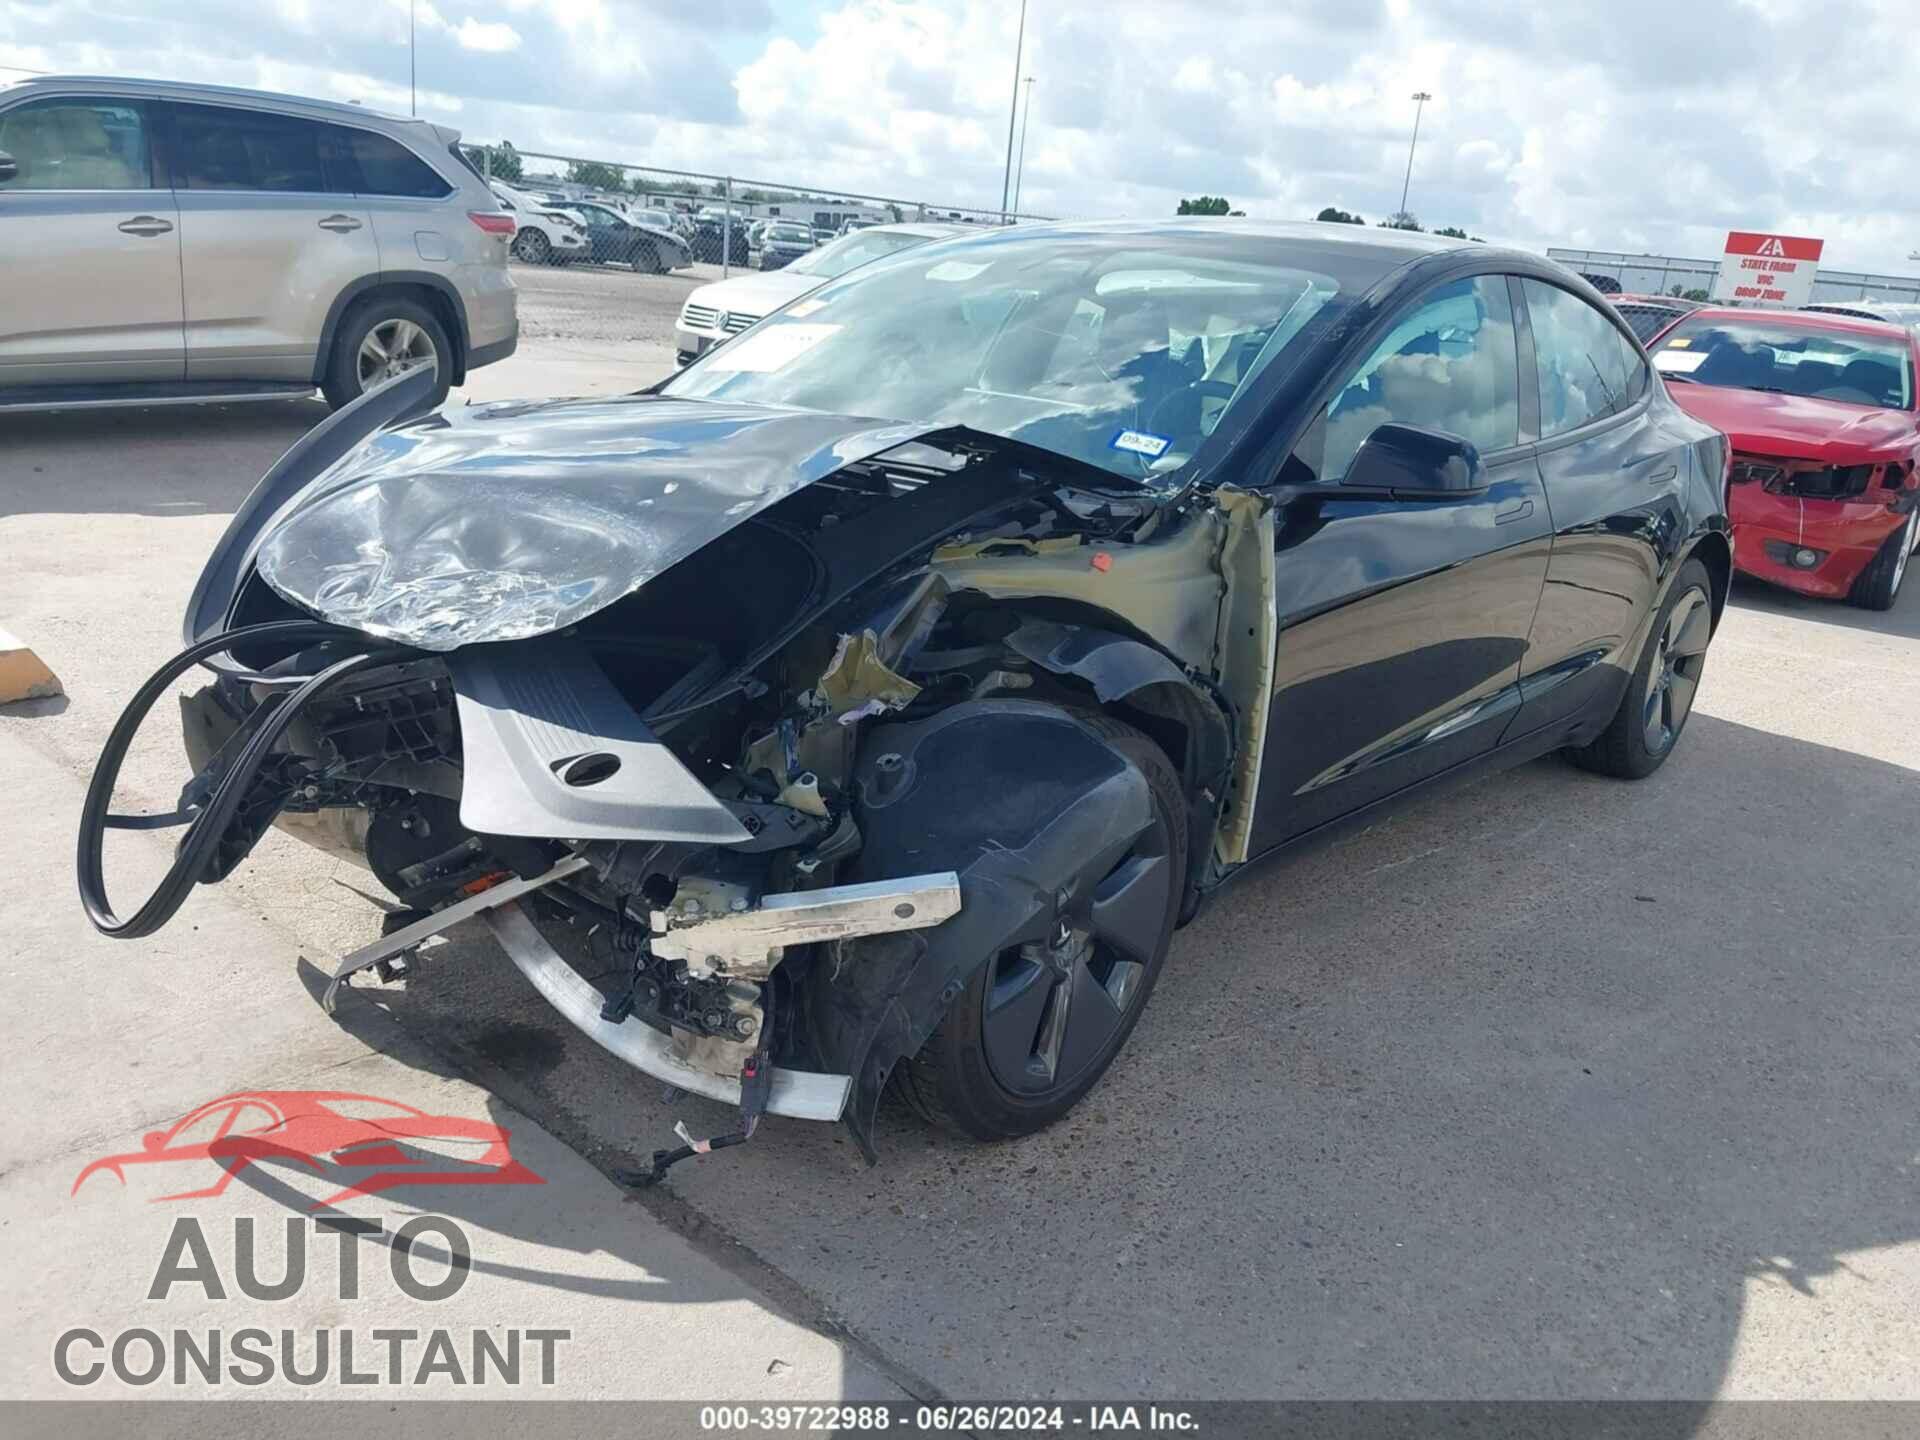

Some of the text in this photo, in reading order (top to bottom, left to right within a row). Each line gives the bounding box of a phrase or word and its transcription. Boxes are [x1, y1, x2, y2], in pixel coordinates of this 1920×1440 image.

[1740, 259, 1796, 272] STATE FARM
[1734, 286, 1786, 300] DROP ZONE
